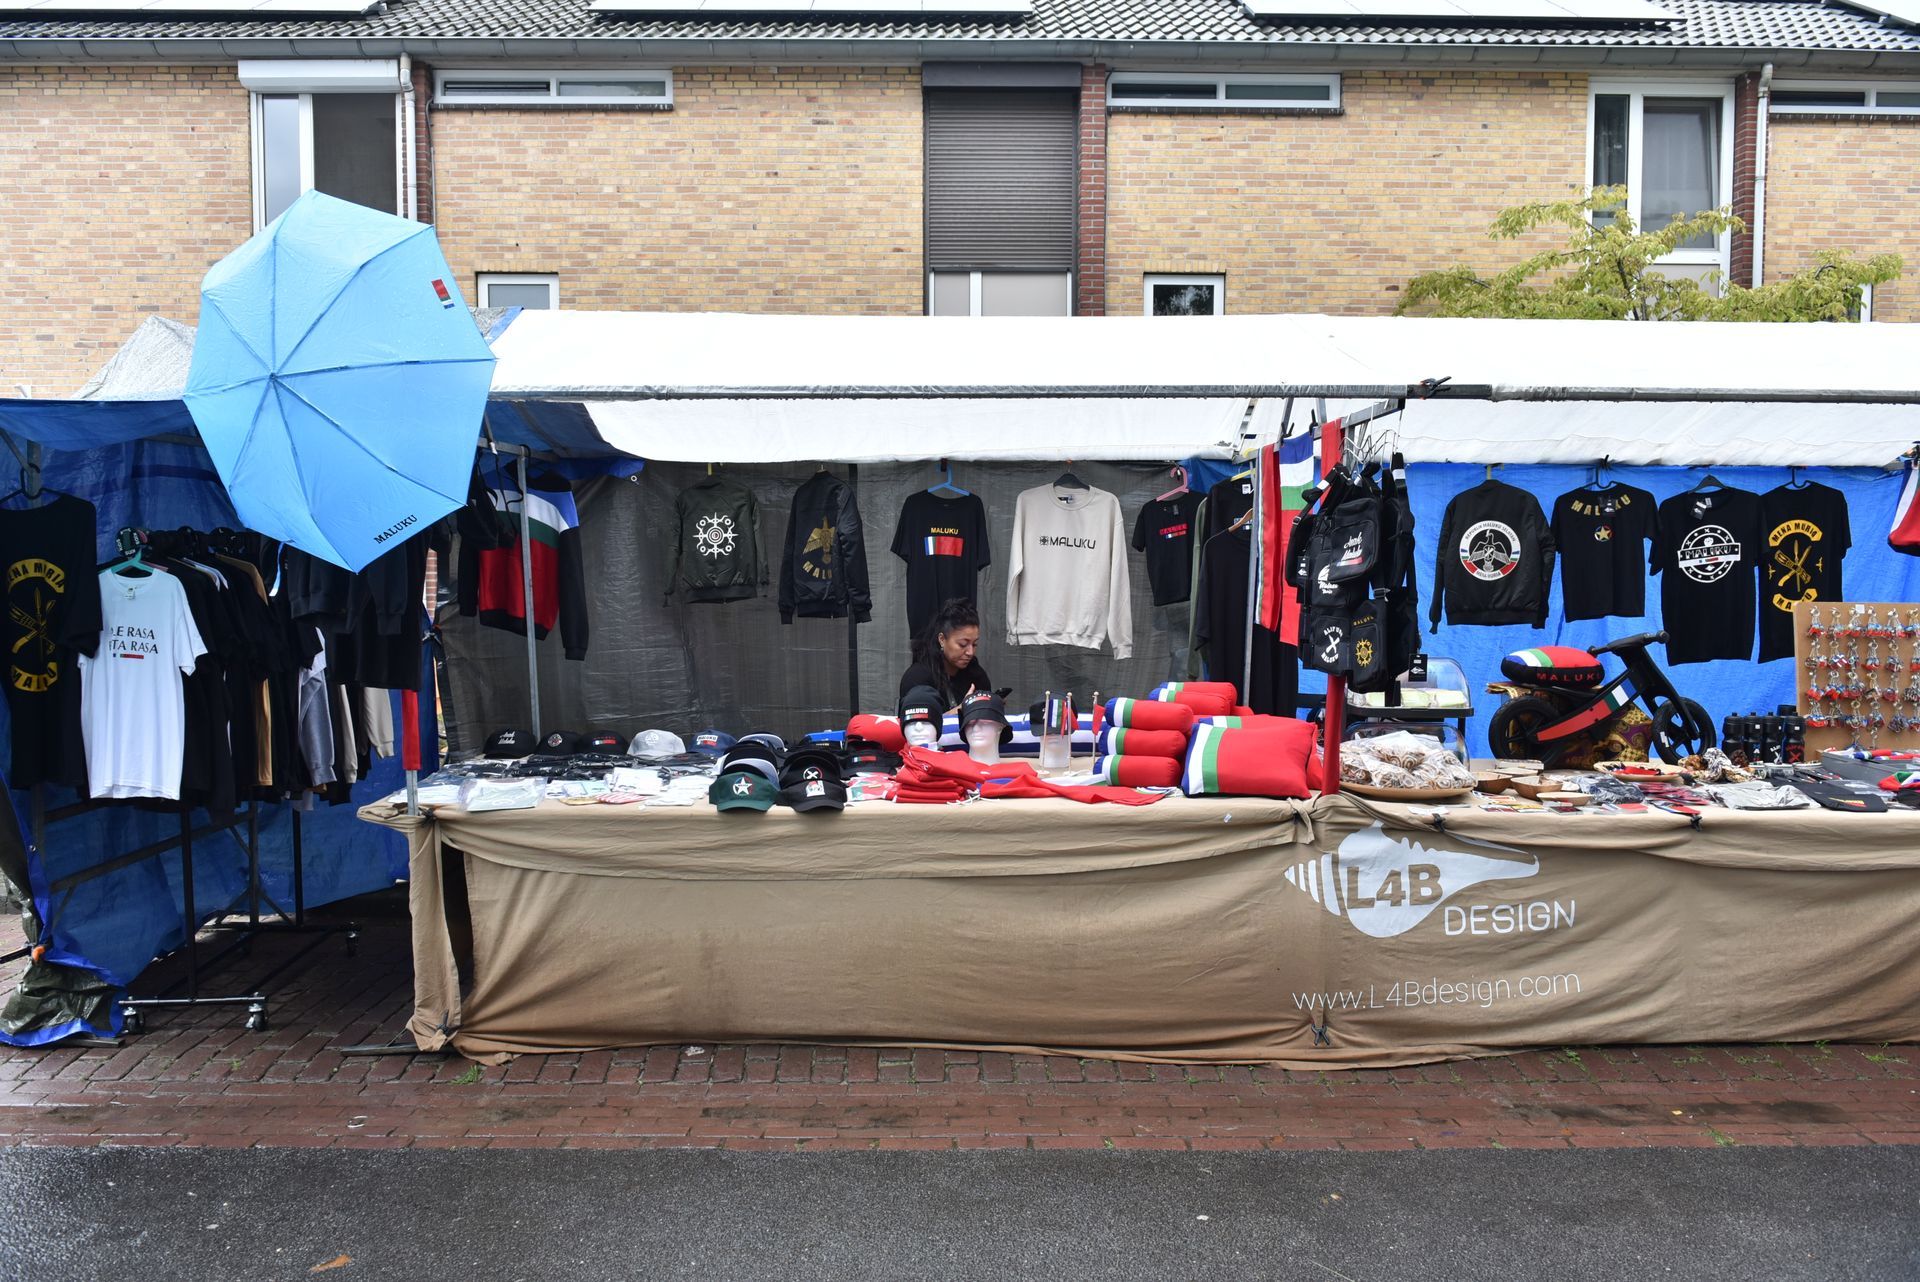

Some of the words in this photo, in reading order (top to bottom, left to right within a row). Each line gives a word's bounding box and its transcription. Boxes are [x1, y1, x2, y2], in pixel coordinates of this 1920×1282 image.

[373, 514, 418, 544] MALUKU
[930, 527, 959, 535] MALUKU
[1771, 524, 1791, 542] MENA
[1050, 536, 1096, 550] MALUKU
[1684, 545, 1733, 560] MALUKU
[127, 626, 155, 640] RASA
[130, 640, 159, 655] RASA
[905, 707, 928, 715] MALUKU
[1346, 863, 1443, 910] L4B
[1443, 899, 1576, 936] DESIGN
[1292, 972, 1582, 1011] www.L4Bdesign.com
